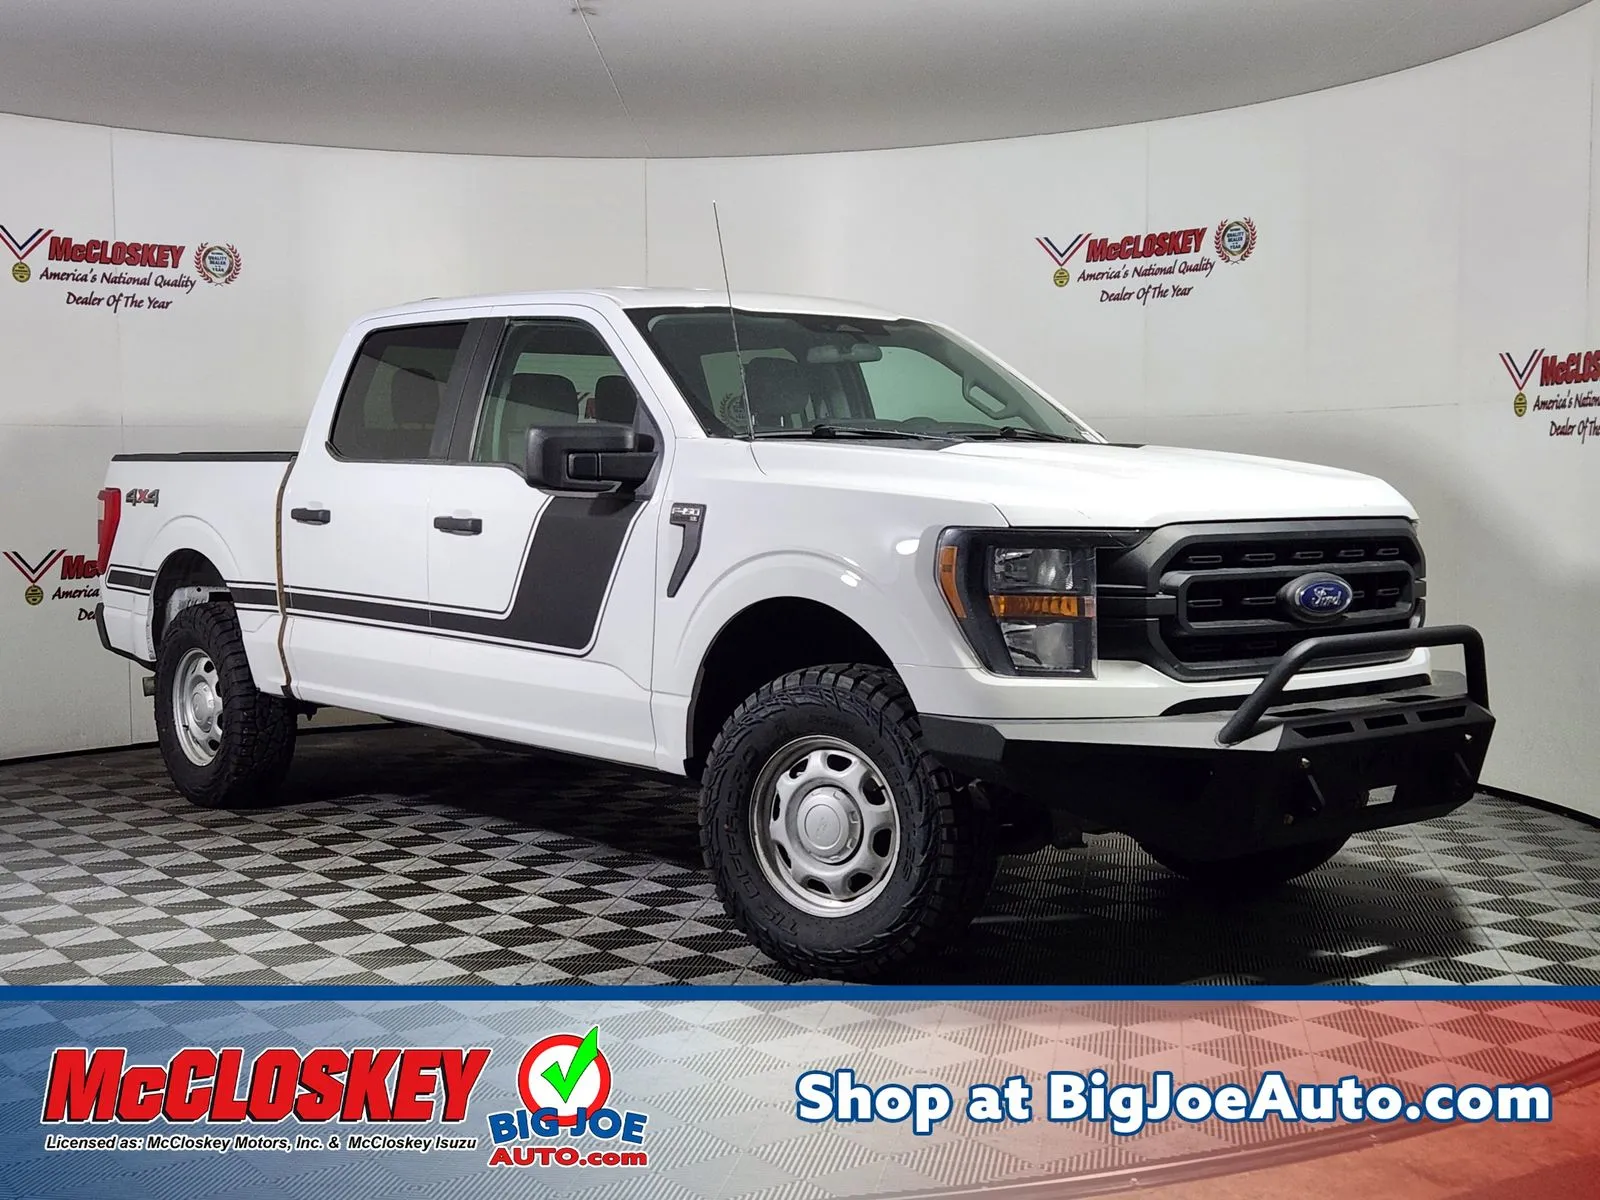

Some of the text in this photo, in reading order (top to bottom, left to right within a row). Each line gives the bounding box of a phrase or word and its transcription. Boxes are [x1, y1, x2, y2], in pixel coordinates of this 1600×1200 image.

[48, 236, 185, 268] McCLOSKEY
[1085, 227, 1207, 263] McCLOSKEY
[39, 267, 97, 283] America's
[100, 272, 152, 286] National
[154, 273, 197, 294] Quality
[1077, 264, 1129, 282] America's
[1132, 259, 1178, 278] National
[1178, 256, 1216, 278] Quality
[66, 291, 173, 313] Dealer Of The Year
[1100, 283, 1194, 305] Dealer Of The Year
[1533, 389, 1573, 412] America's
[1549, 417, 1576, 437] Dealer
[1577, 416, 1589, 444] Of
[1312, 587, 1341, 605] Ford
